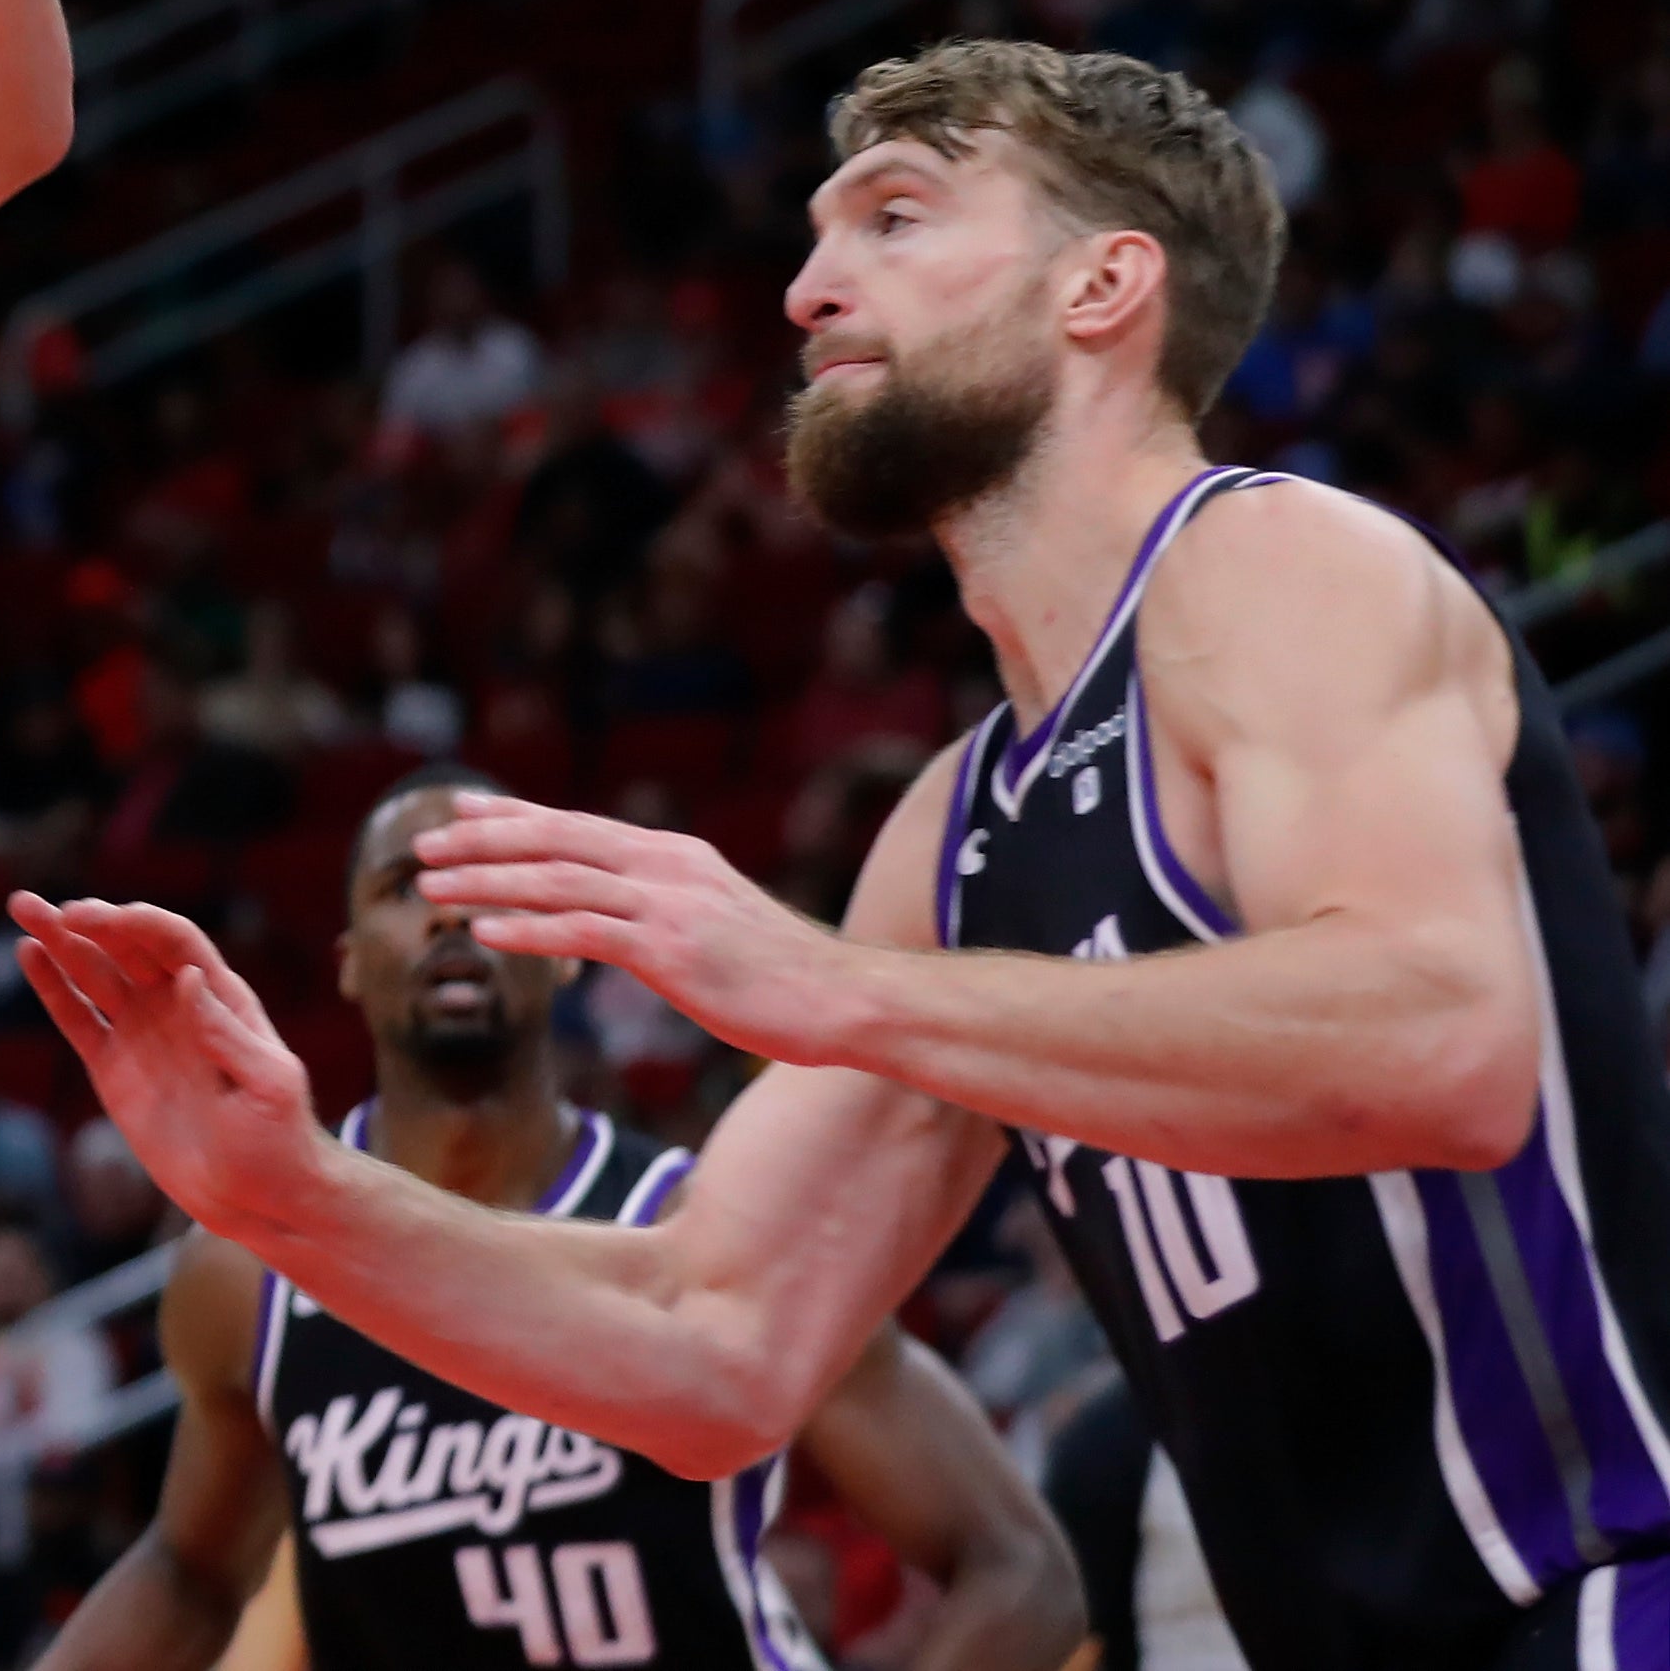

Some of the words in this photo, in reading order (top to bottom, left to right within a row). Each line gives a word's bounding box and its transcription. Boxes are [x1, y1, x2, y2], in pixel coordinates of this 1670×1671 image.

[1106, 1156, 1259, 1344] 10
[285, 1386, 622, 1560] Kings
[455, 1540, 657, 1667] 40
